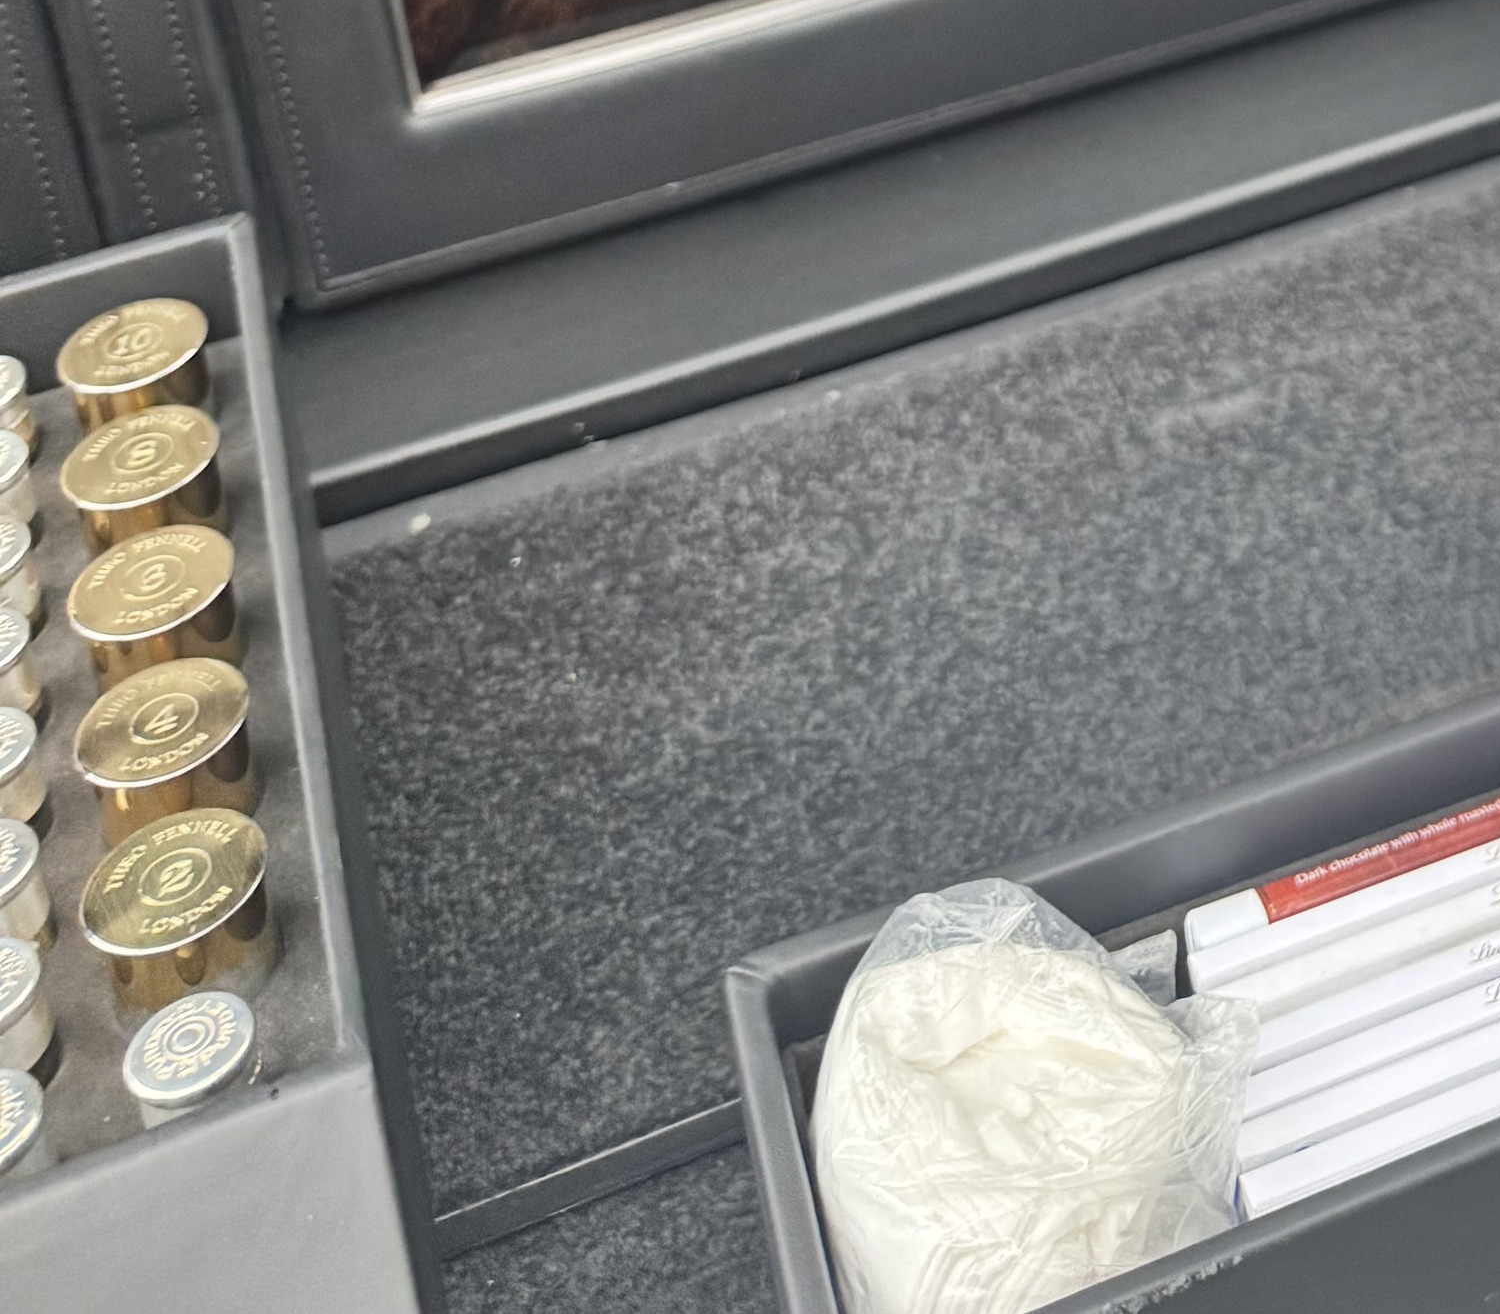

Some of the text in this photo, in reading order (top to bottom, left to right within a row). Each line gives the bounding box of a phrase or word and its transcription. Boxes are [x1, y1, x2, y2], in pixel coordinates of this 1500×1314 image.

[113, 327, 152, 356] 10
[143, 703, 179, 735] 4
[1293, 864, 1328, 887] Dark
[1329, 840, 1390, 874] chocolate
[1390, 828, 1419, 850] with
[1417, 815, 1457, 841] whole
[155, 858, 195, 898] 2
[138, 884, 234, 935] LONDON
